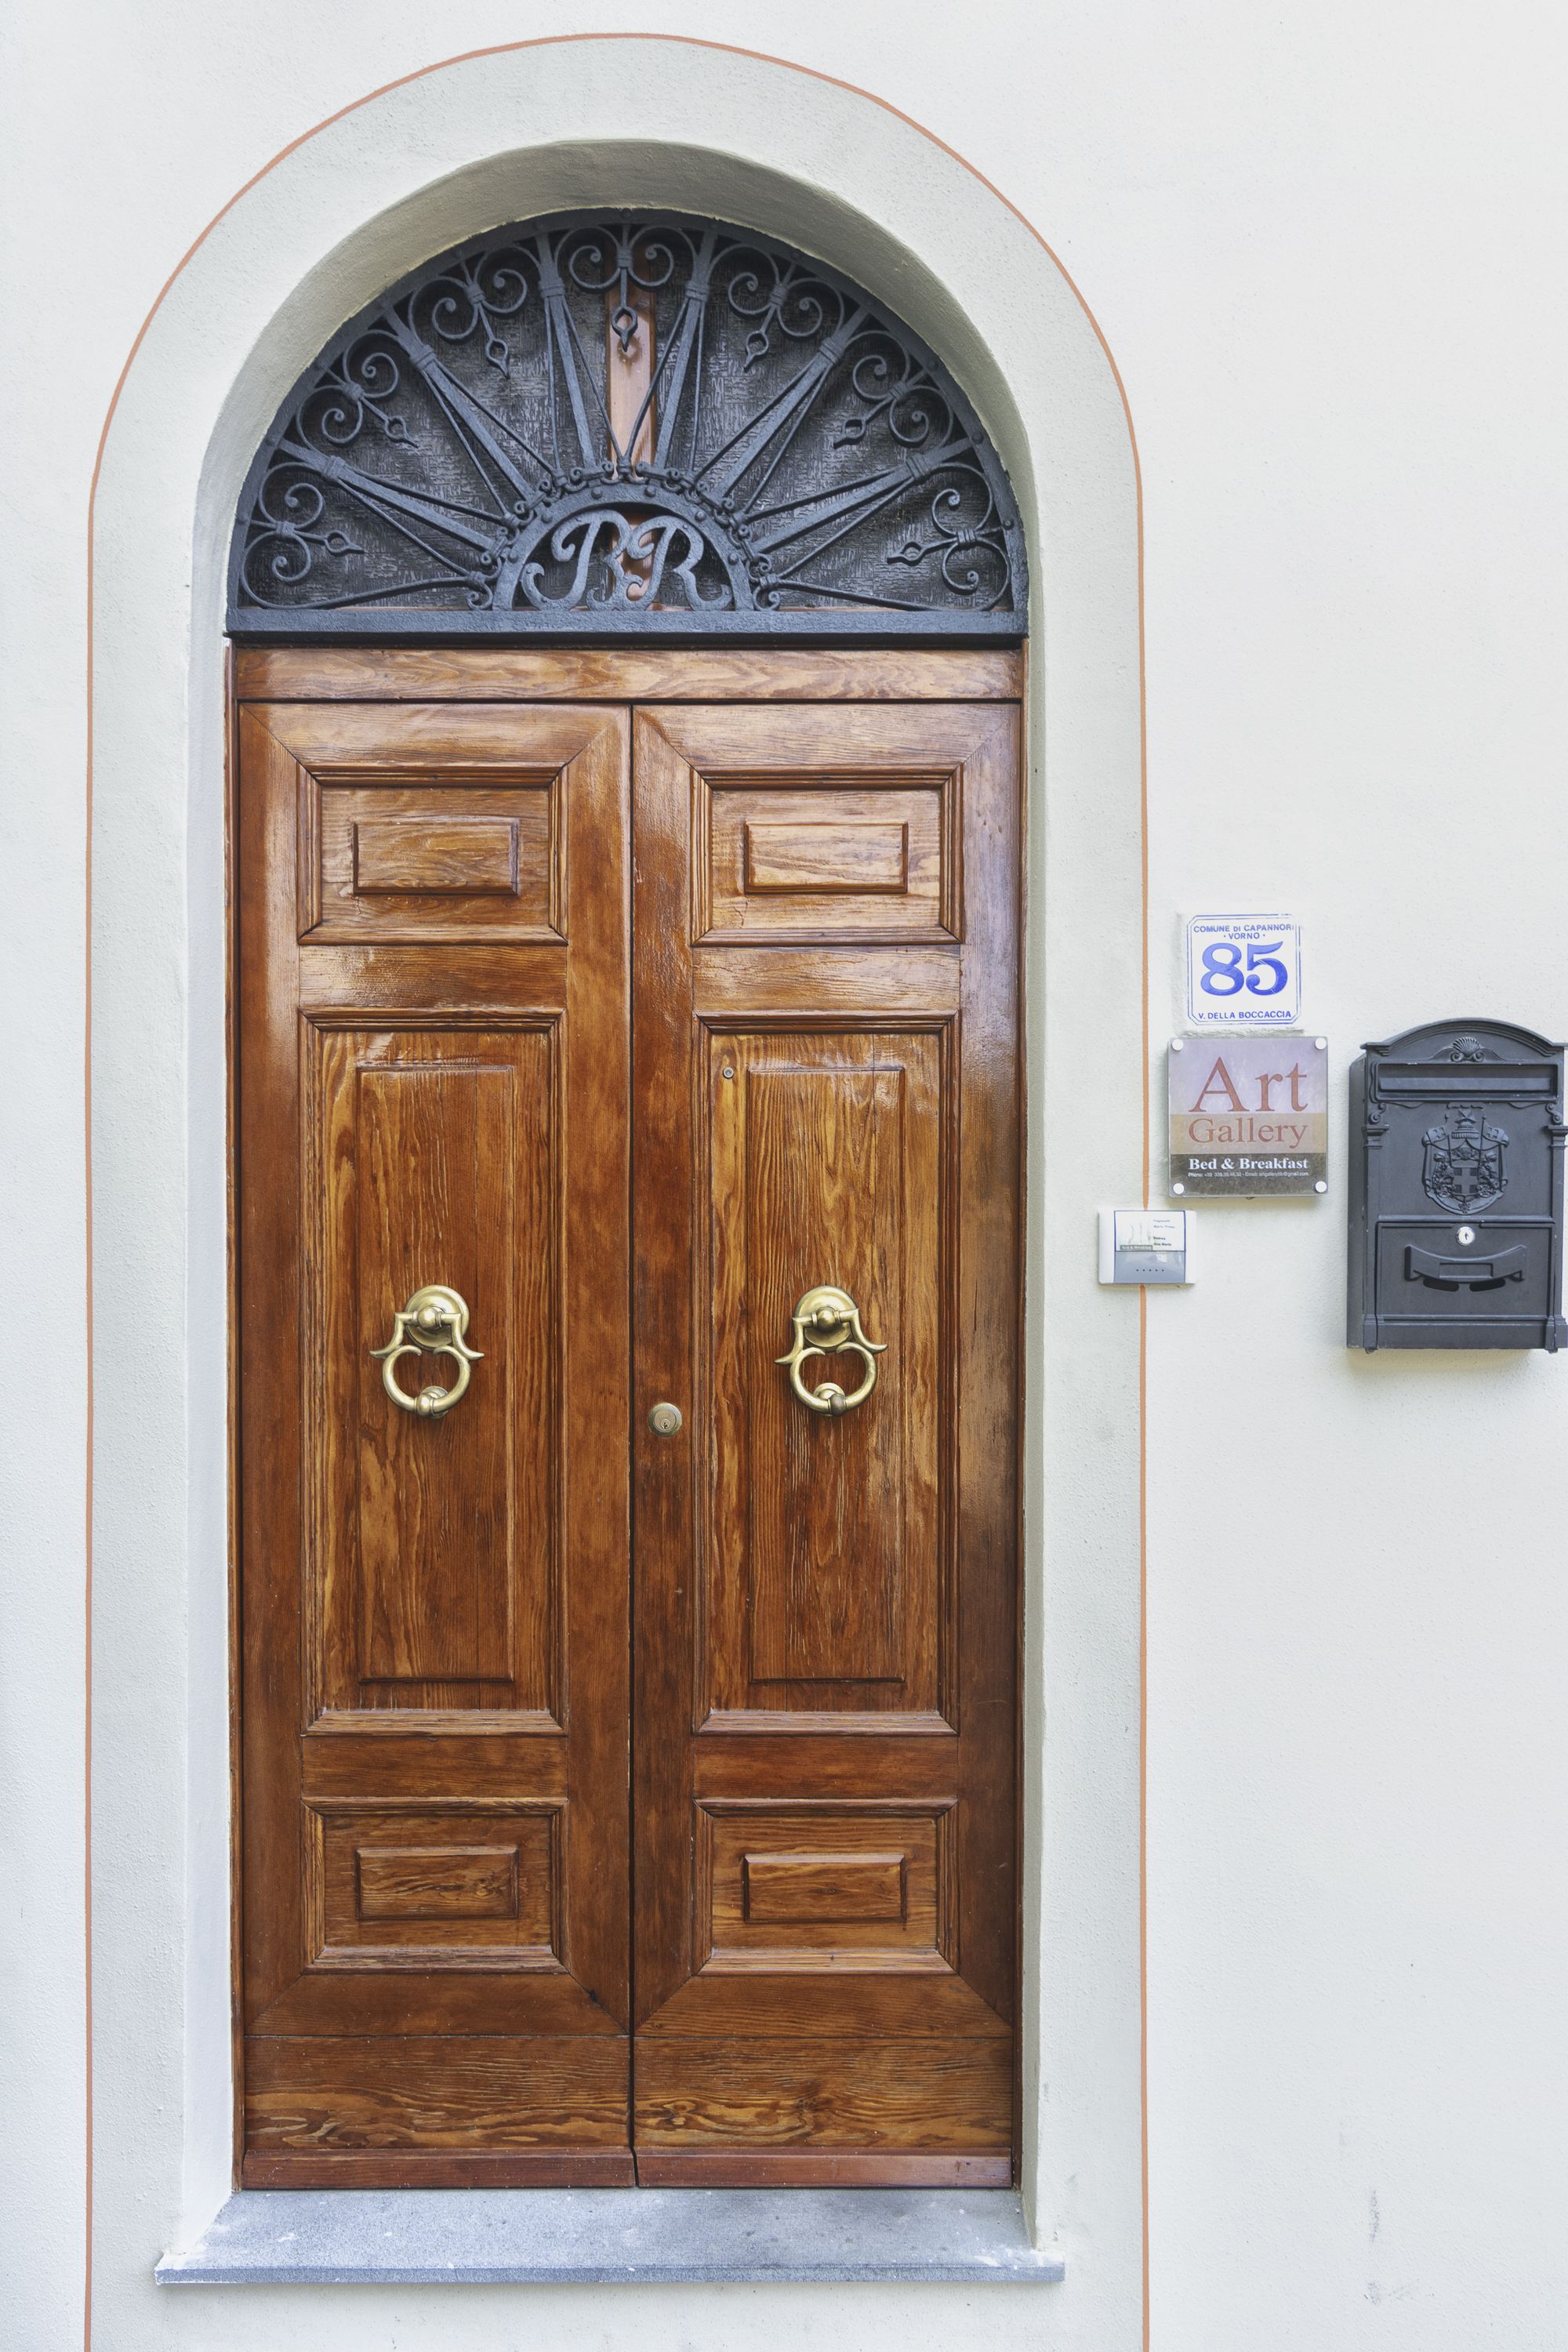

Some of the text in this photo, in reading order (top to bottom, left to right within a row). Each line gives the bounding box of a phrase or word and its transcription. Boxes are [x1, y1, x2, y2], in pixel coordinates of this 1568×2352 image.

[1200, 941, 1288, 996] 85
[1188, 1056, 1308, 1112] Art
[1188, 1117, 1308, 1149] Gallery
[1189, 1158, 1308, 1170] Bed & Breakfast
